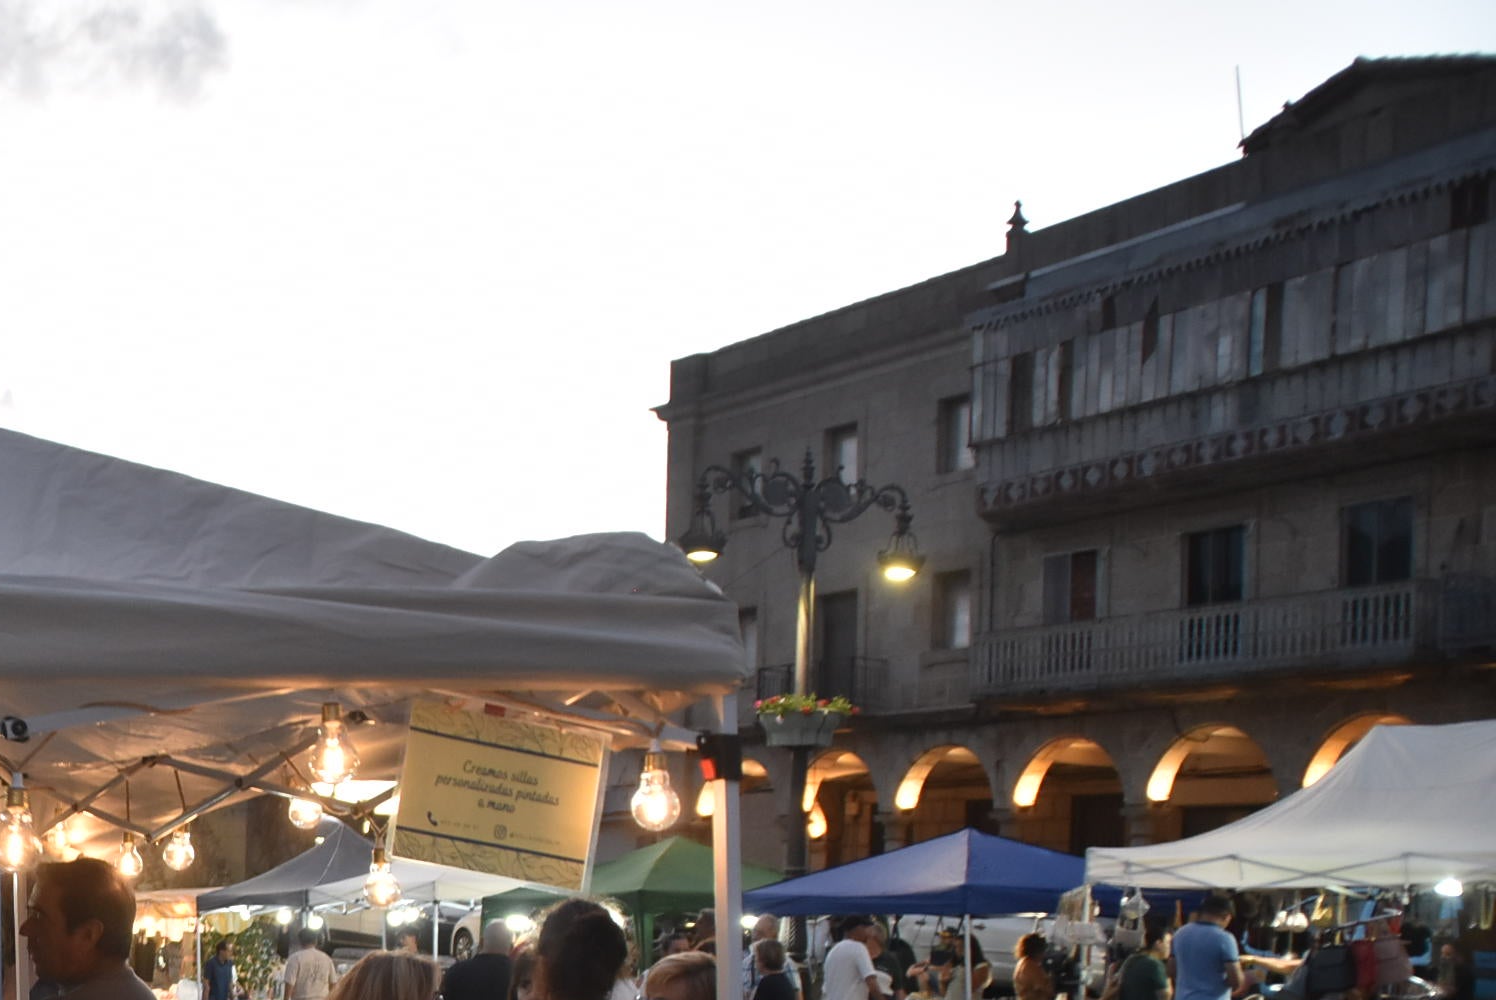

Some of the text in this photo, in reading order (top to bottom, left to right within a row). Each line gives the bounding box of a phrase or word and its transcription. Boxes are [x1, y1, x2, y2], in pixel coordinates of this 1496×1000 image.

[463, 760, 538, 786] Creamos sillas
[435, 774, 560, 806] personalizadas pintadas
[486, 800, 515, 813] mano
